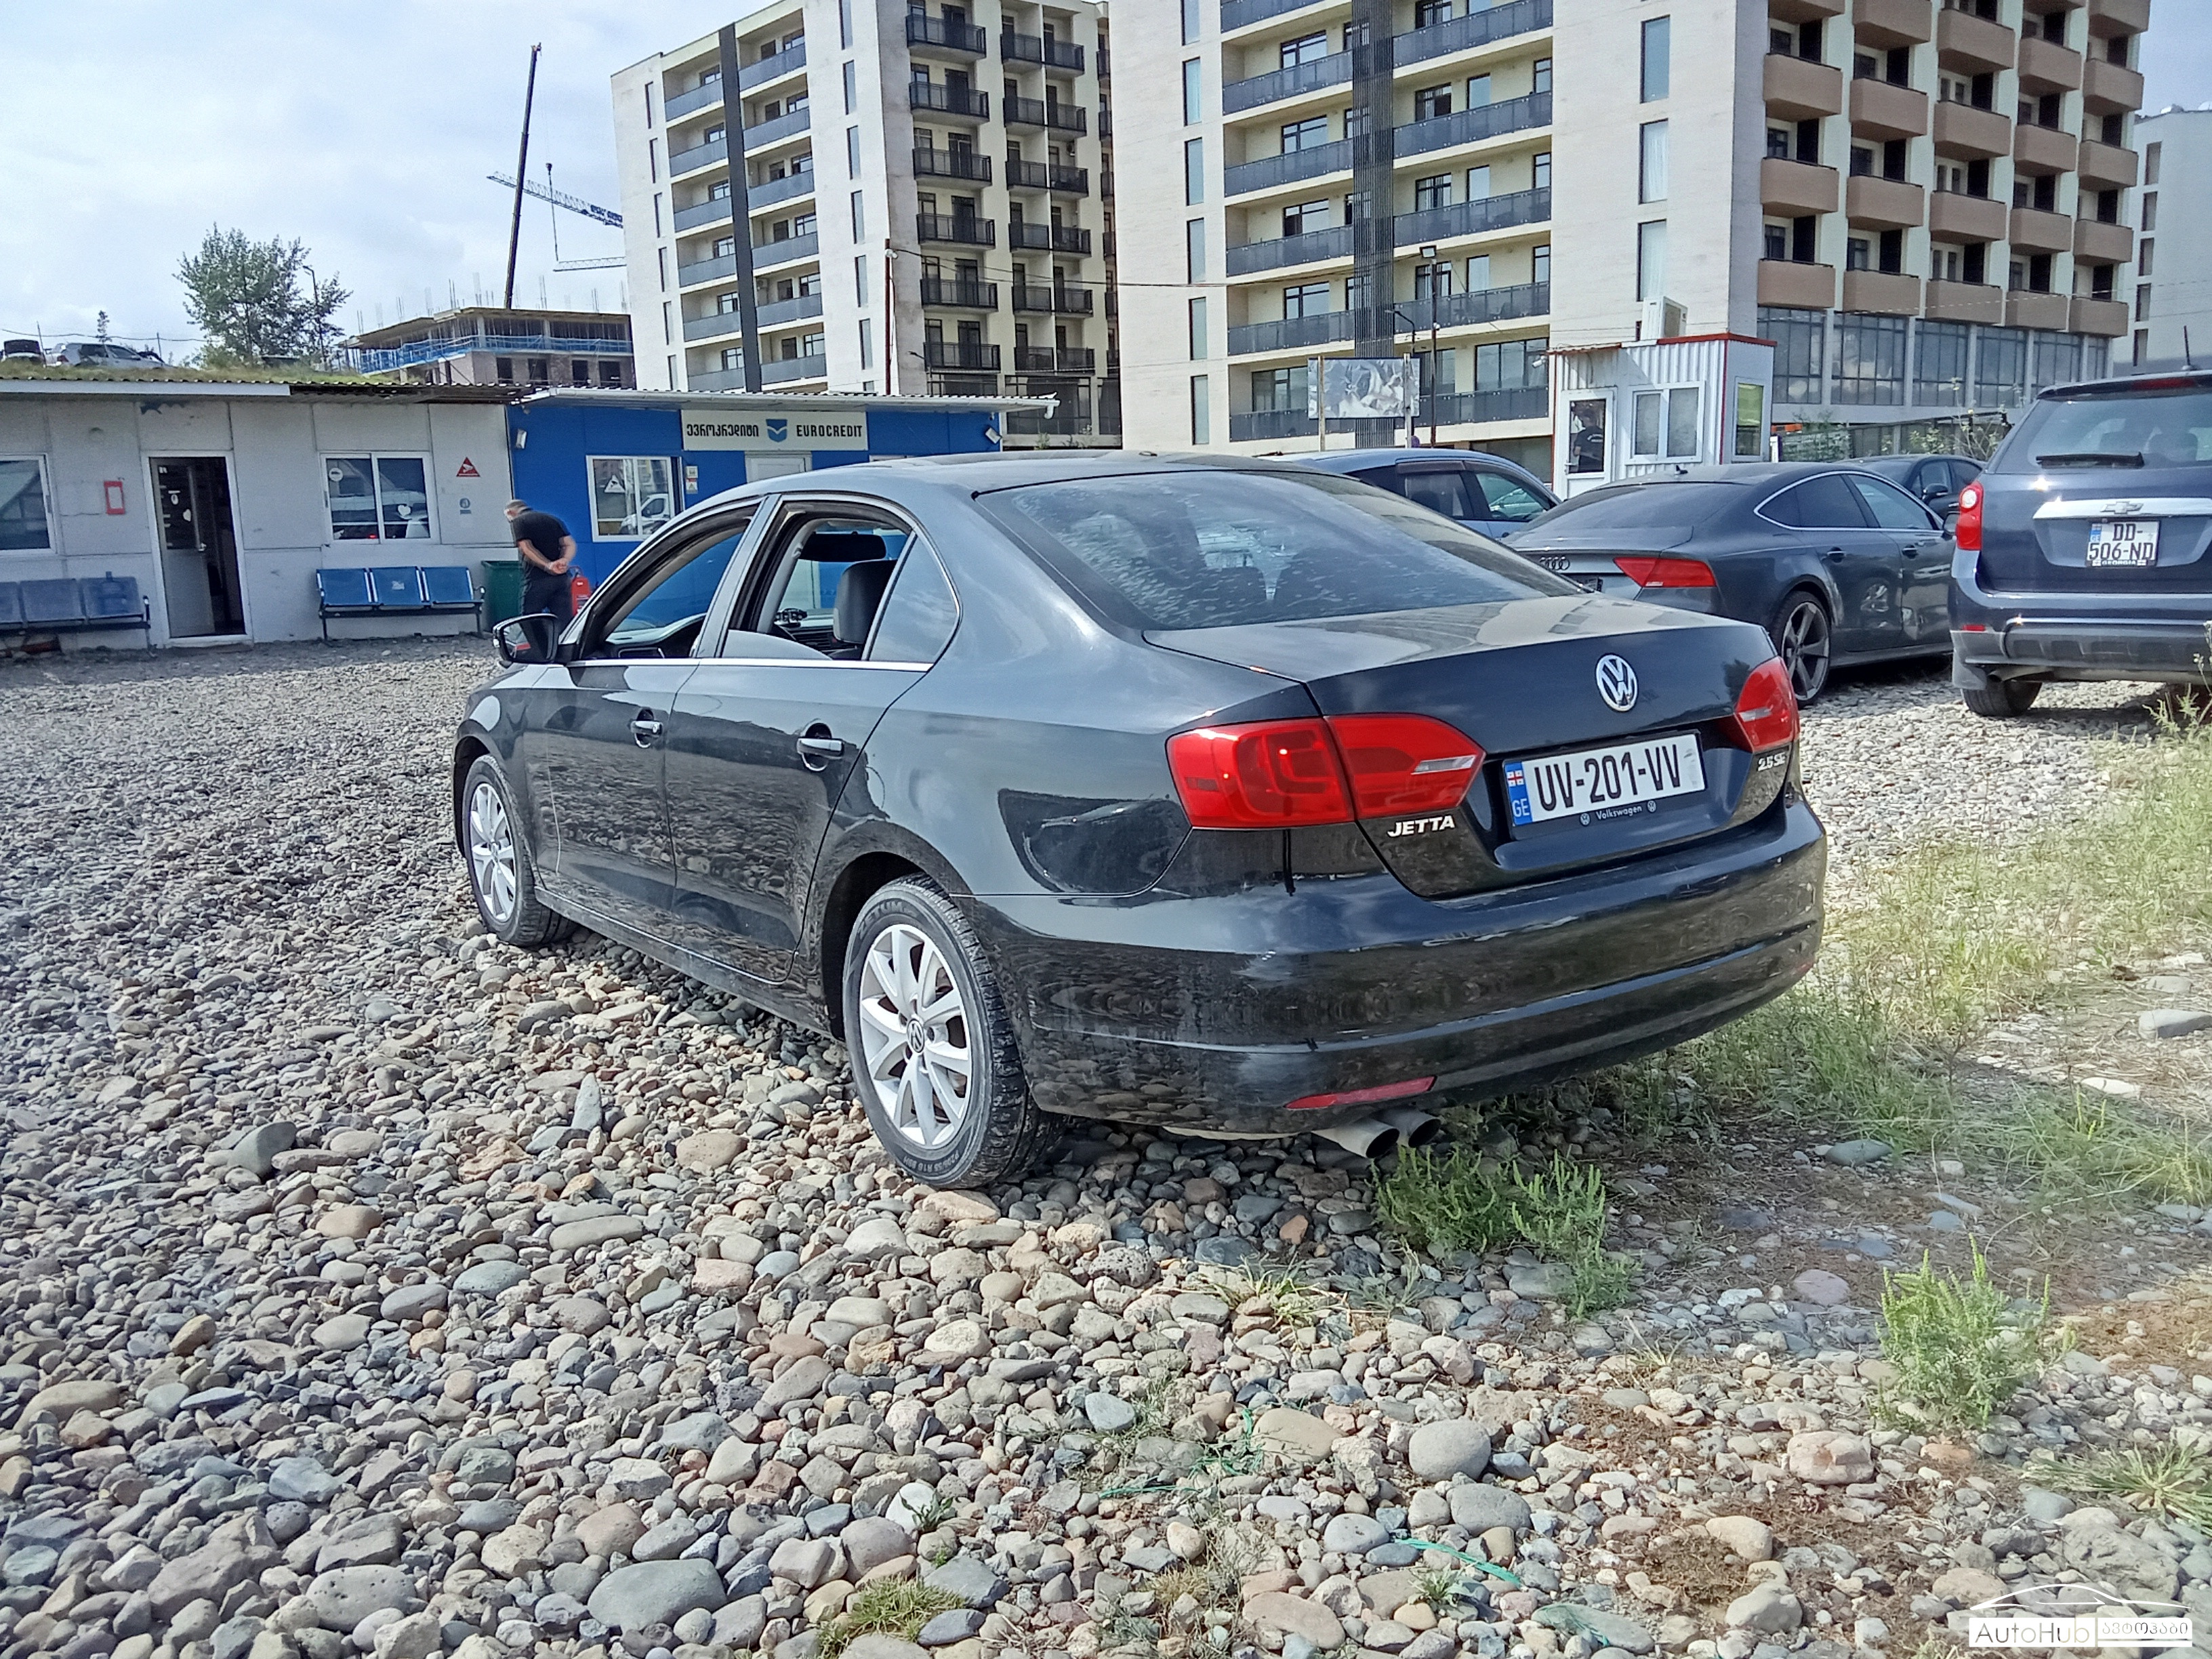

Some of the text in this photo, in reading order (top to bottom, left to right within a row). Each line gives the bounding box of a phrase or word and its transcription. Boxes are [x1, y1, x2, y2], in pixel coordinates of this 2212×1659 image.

[687, 424, 759, 437] ევროკრედიტი
[796, 424, 863, 437] EUROCREDIT
[2089, 542, 2154, 560] 506-ND
[1534, 744, 1681, 812] UV-201-VV
[1512, 798, 1530, 818] GE
[1595, 806, 1643, 821] Volkswagen
[1387, 815, 1456, 838] JETTA
